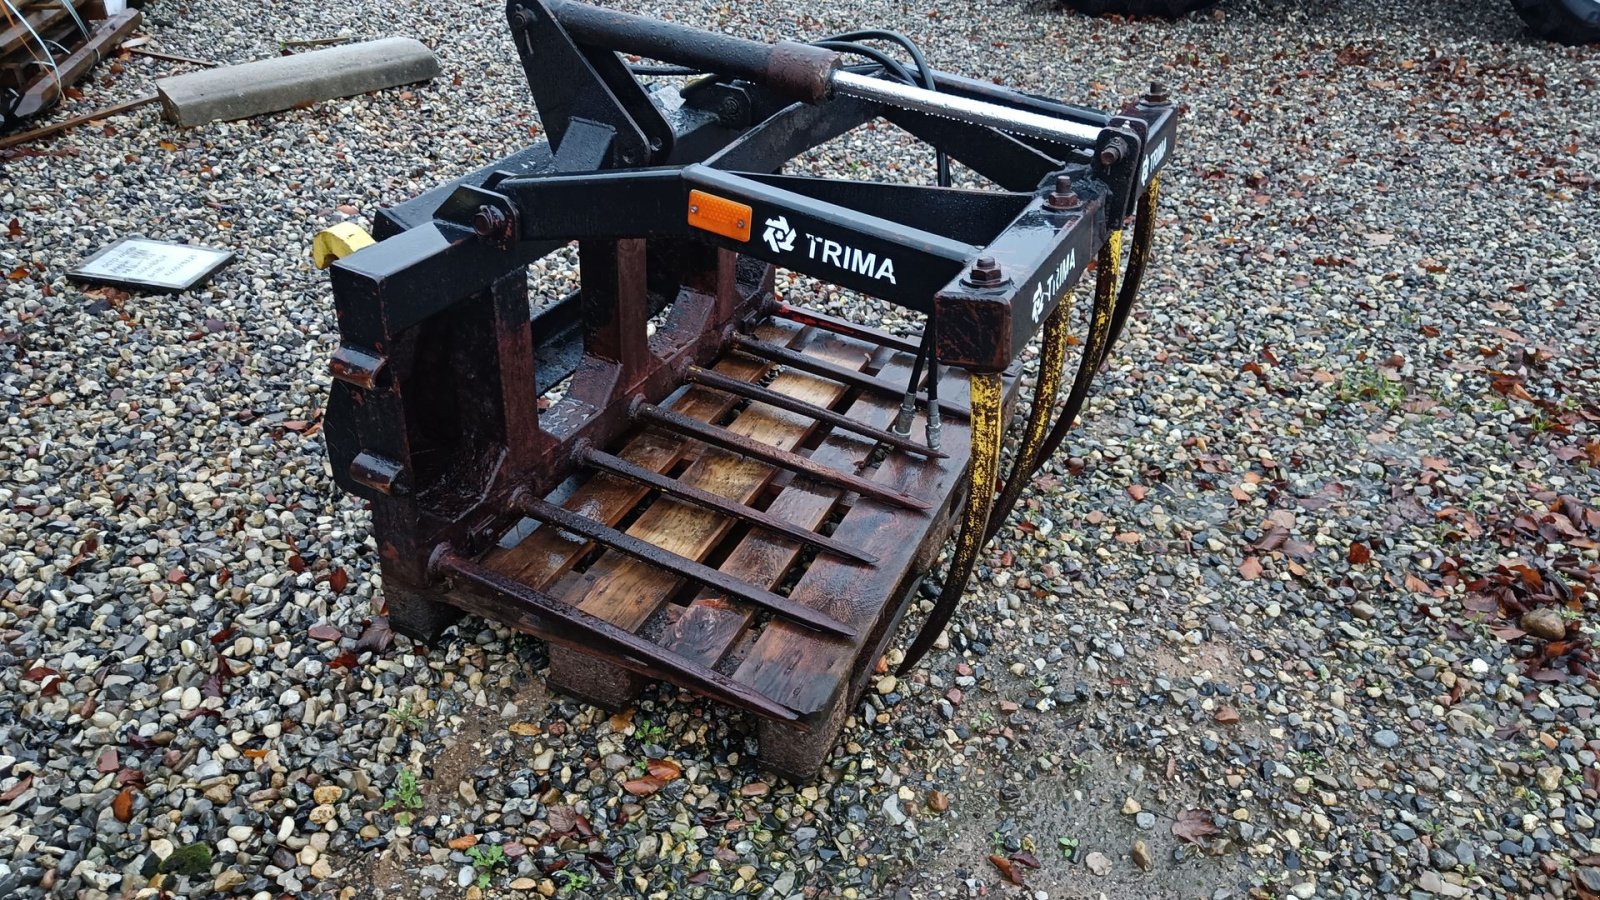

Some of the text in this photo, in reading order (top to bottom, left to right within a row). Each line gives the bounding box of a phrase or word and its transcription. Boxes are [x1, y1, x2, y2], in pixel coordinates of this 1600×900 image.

[1150, 136, 1167, 173] TRIMA
[806, 233, 897, 286] TRIMA
[1046, 247, 1076, 302] TRIMA
